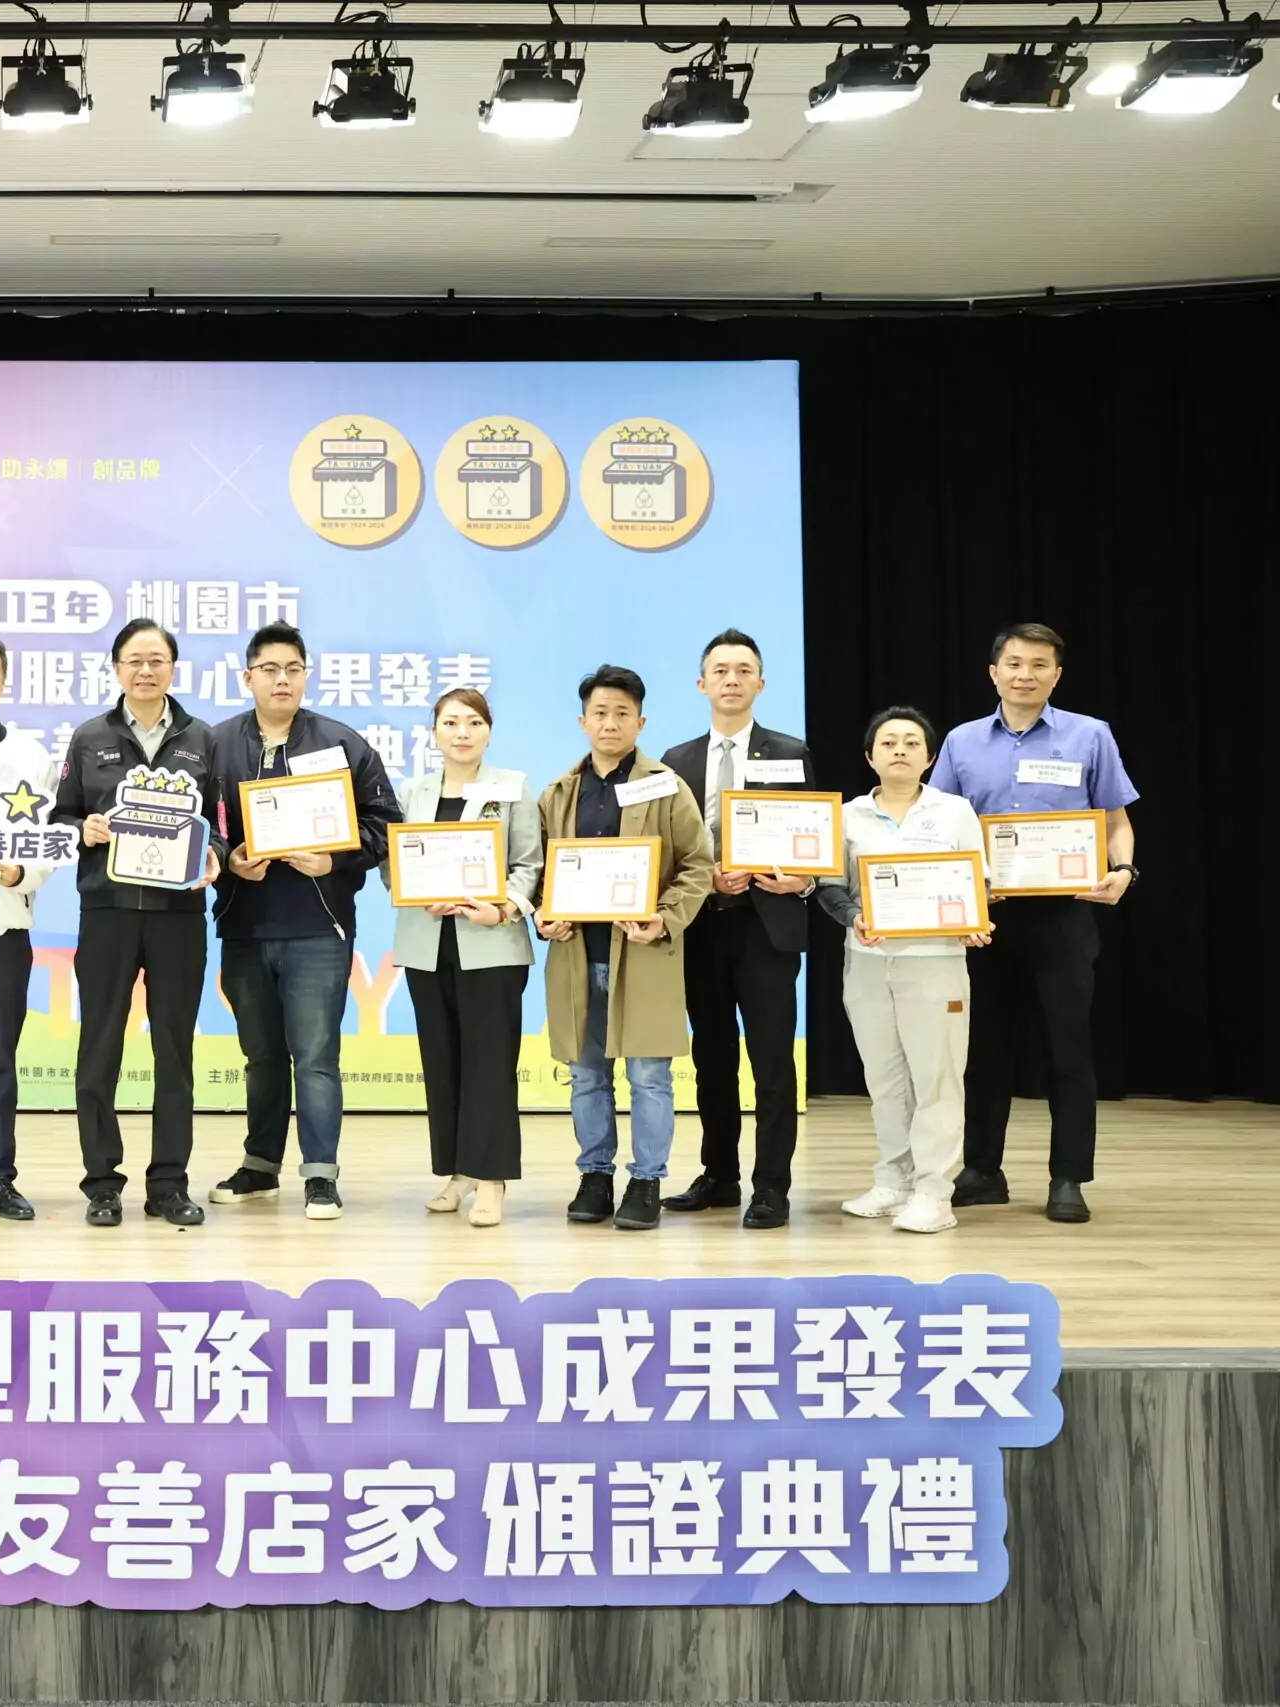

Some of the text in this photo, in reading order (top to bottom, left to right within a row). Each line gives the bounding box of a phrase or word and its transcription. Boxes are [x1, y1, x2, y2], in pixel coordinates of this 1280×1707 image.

[92, 457, 161, 481] 創品牌
[126, 580, 300, 635] 桃園市
[19, 1066, 76, 1078] 桃園市政
[208, 1068, 247, 1084] 主辦
